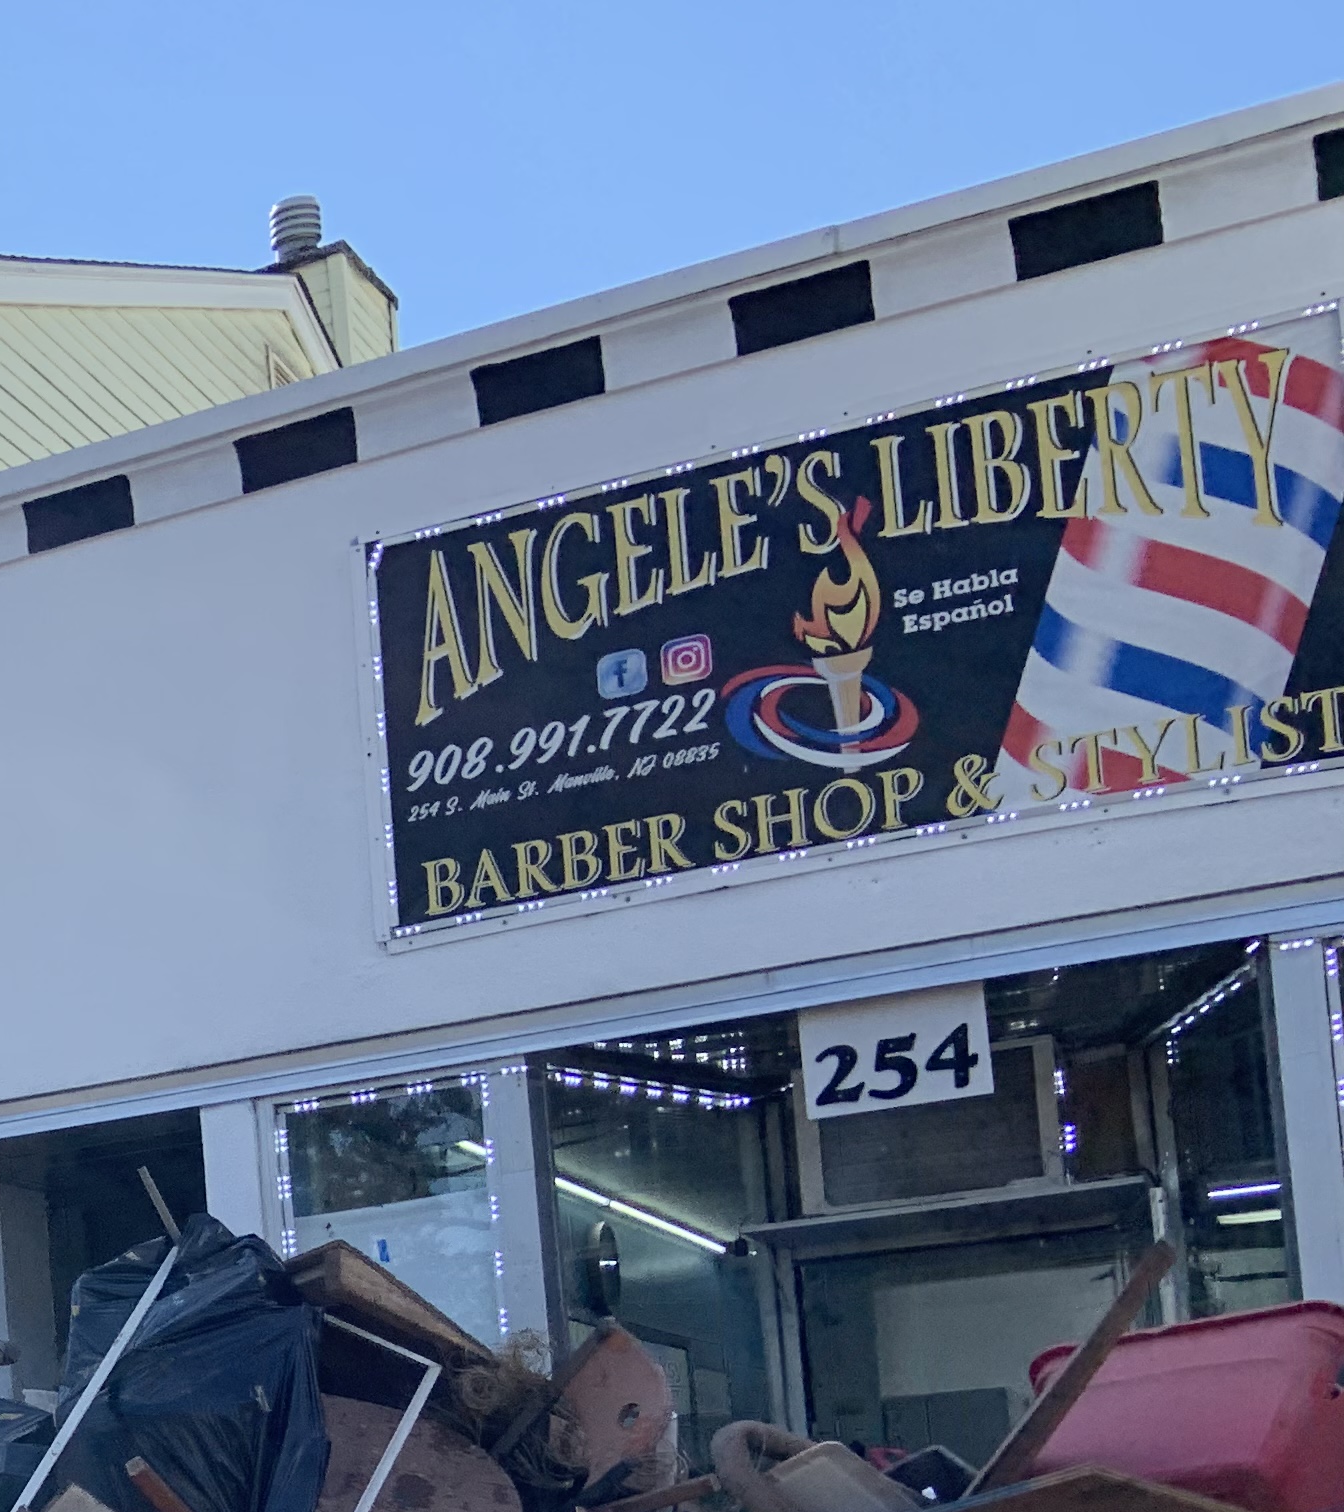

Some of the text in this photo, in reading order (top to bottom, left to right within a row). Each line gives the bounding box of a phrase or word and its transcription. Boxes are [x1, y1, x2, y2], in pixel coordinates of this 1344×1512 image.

[415, 347, 1290, 726] ANGELE'S LIBERTY
[893, 568, 1018, 608] Se Habla
[902, 594, 1014, 634] Español
[406, 688, 716, 792] 908.991.7722
[407, 801, 441, 822] 254
[470, 787, 512, 811] Main
[663, 742, 720, 770] 08835
[421, 685, 1344, 916] BARBER SHOP & STYLIST
[815, 1022, 979, 1106] 254
